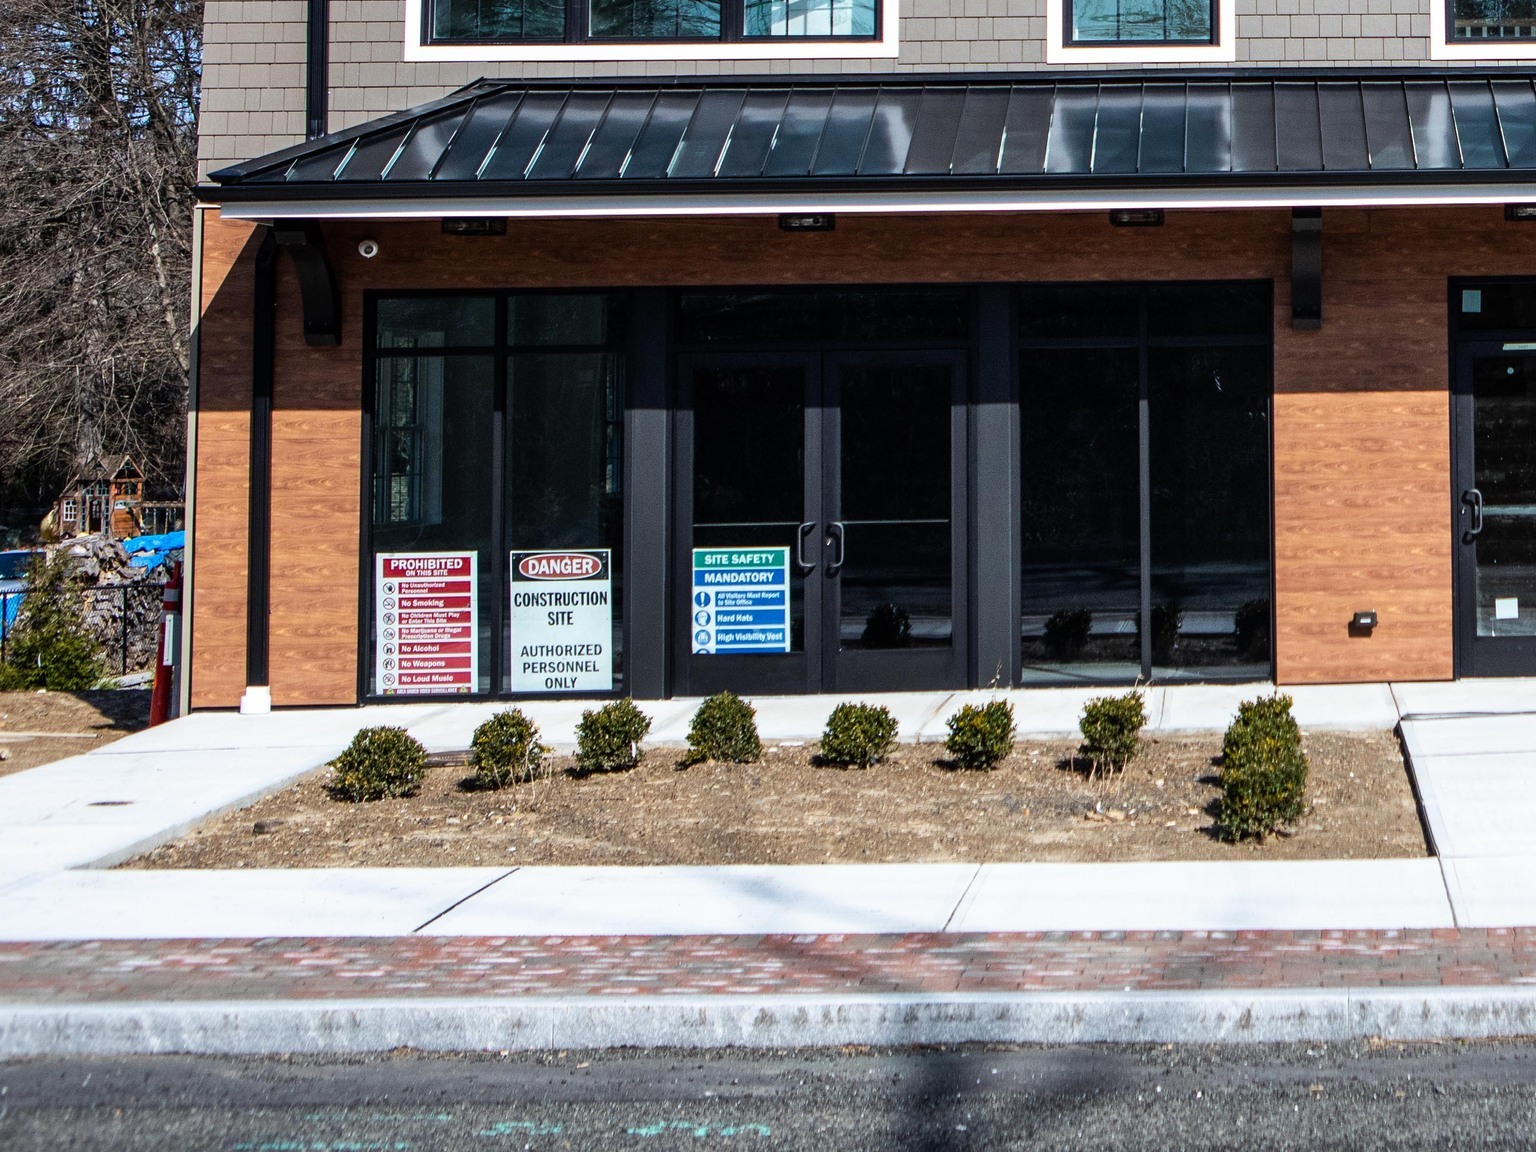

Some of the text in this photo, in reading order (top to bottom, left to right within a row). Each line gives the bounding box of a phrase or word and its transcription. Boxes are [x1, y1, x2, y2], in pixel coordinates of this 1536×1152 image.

[390, 559, 463, 570] PROHIBITED
[704, 553, 775, 565] SITE SAFETY
[528, 558, 593, 574] DANGER
[704, 572, 774, 583] MANDATORY
[412, 599, 444, 607] Smoking
[514, 591, 608, 607] CONSTRUCTION
[547, 611, 574, 625] SITE
[717, 614, 753, 622] Hard Hats
[717, 632, 783, 643] High Visibility Vest
[412, 644, 440, 652] Alcohol
[520, 644, 603, 657] AUTHORIZED
[412, 660, 445, 668] Weapons
[522, 661, 600, 674] PERSONNEL
[431, 674, 454, 682] Music
[545, 677, 577, 689] ONLY
